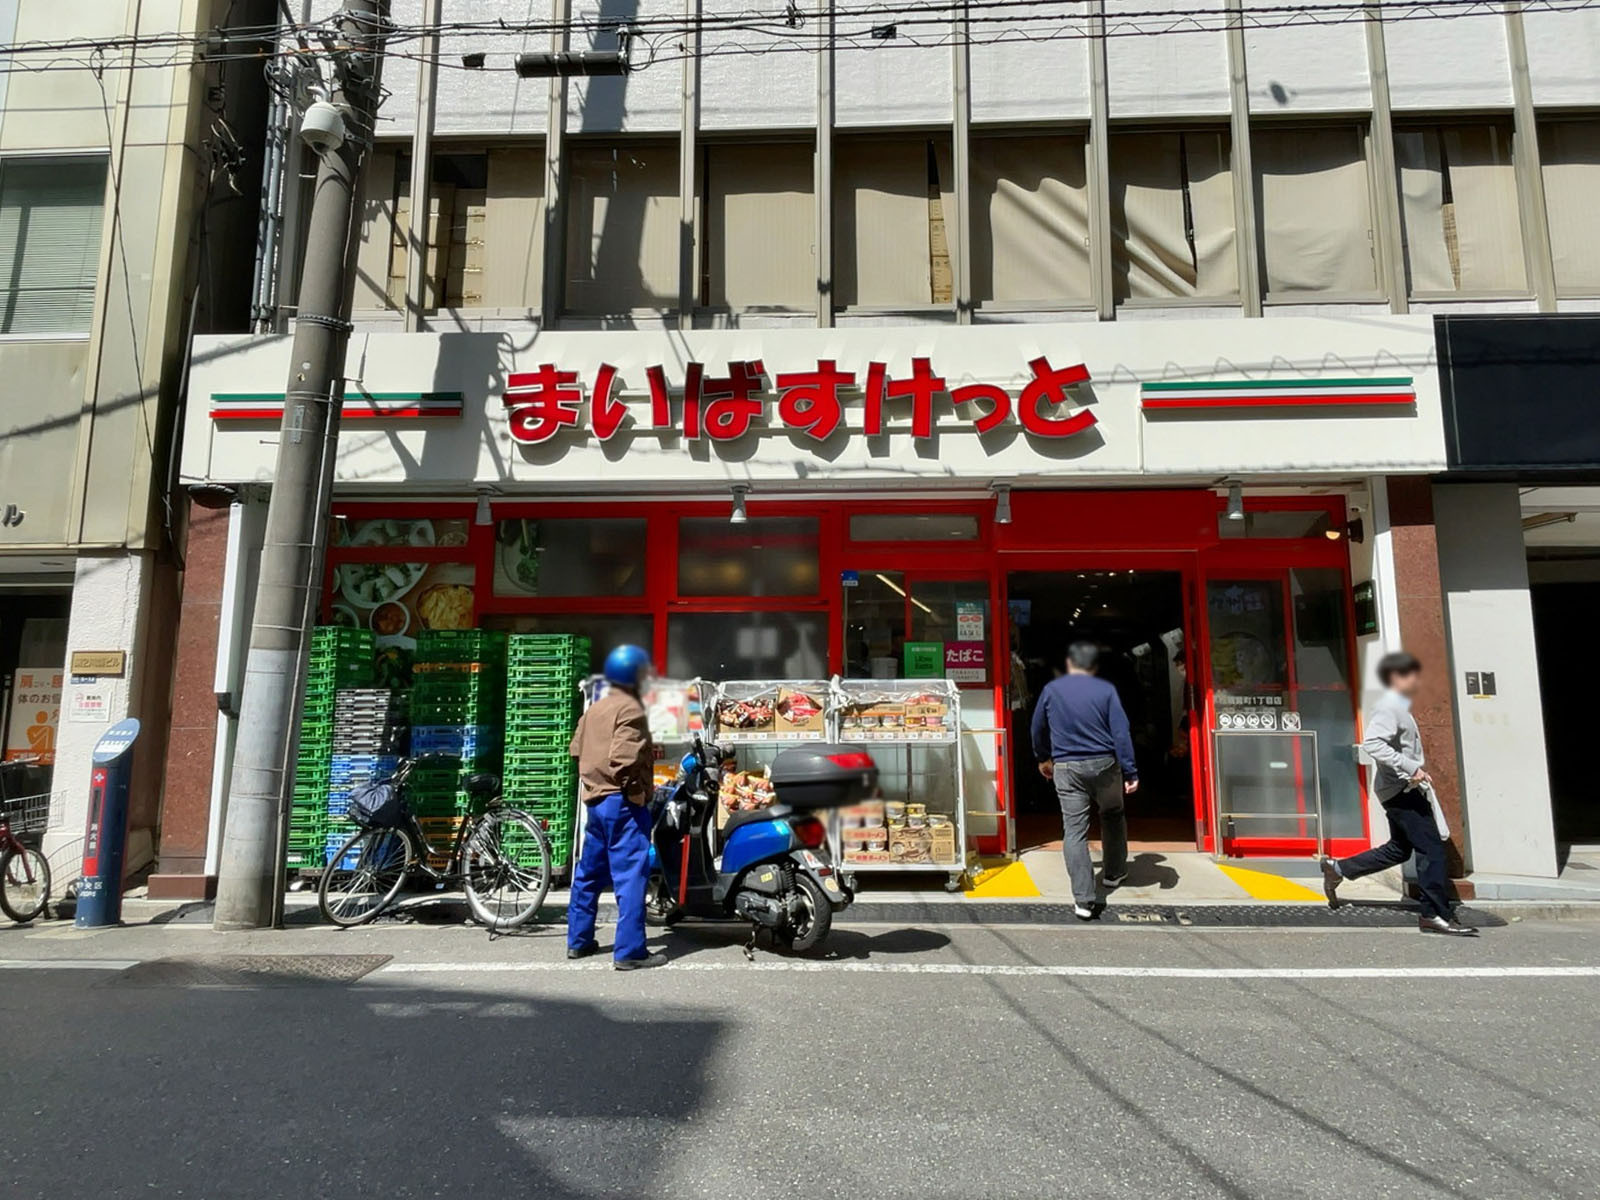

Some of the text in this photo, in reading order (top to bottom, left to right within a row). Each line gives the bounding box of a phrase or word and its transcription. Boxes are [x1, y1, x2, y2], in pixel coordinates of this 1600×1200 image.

[502, 355, 1099, 442] まいばすけっと
[946, 649, 984, 662] たばこ
